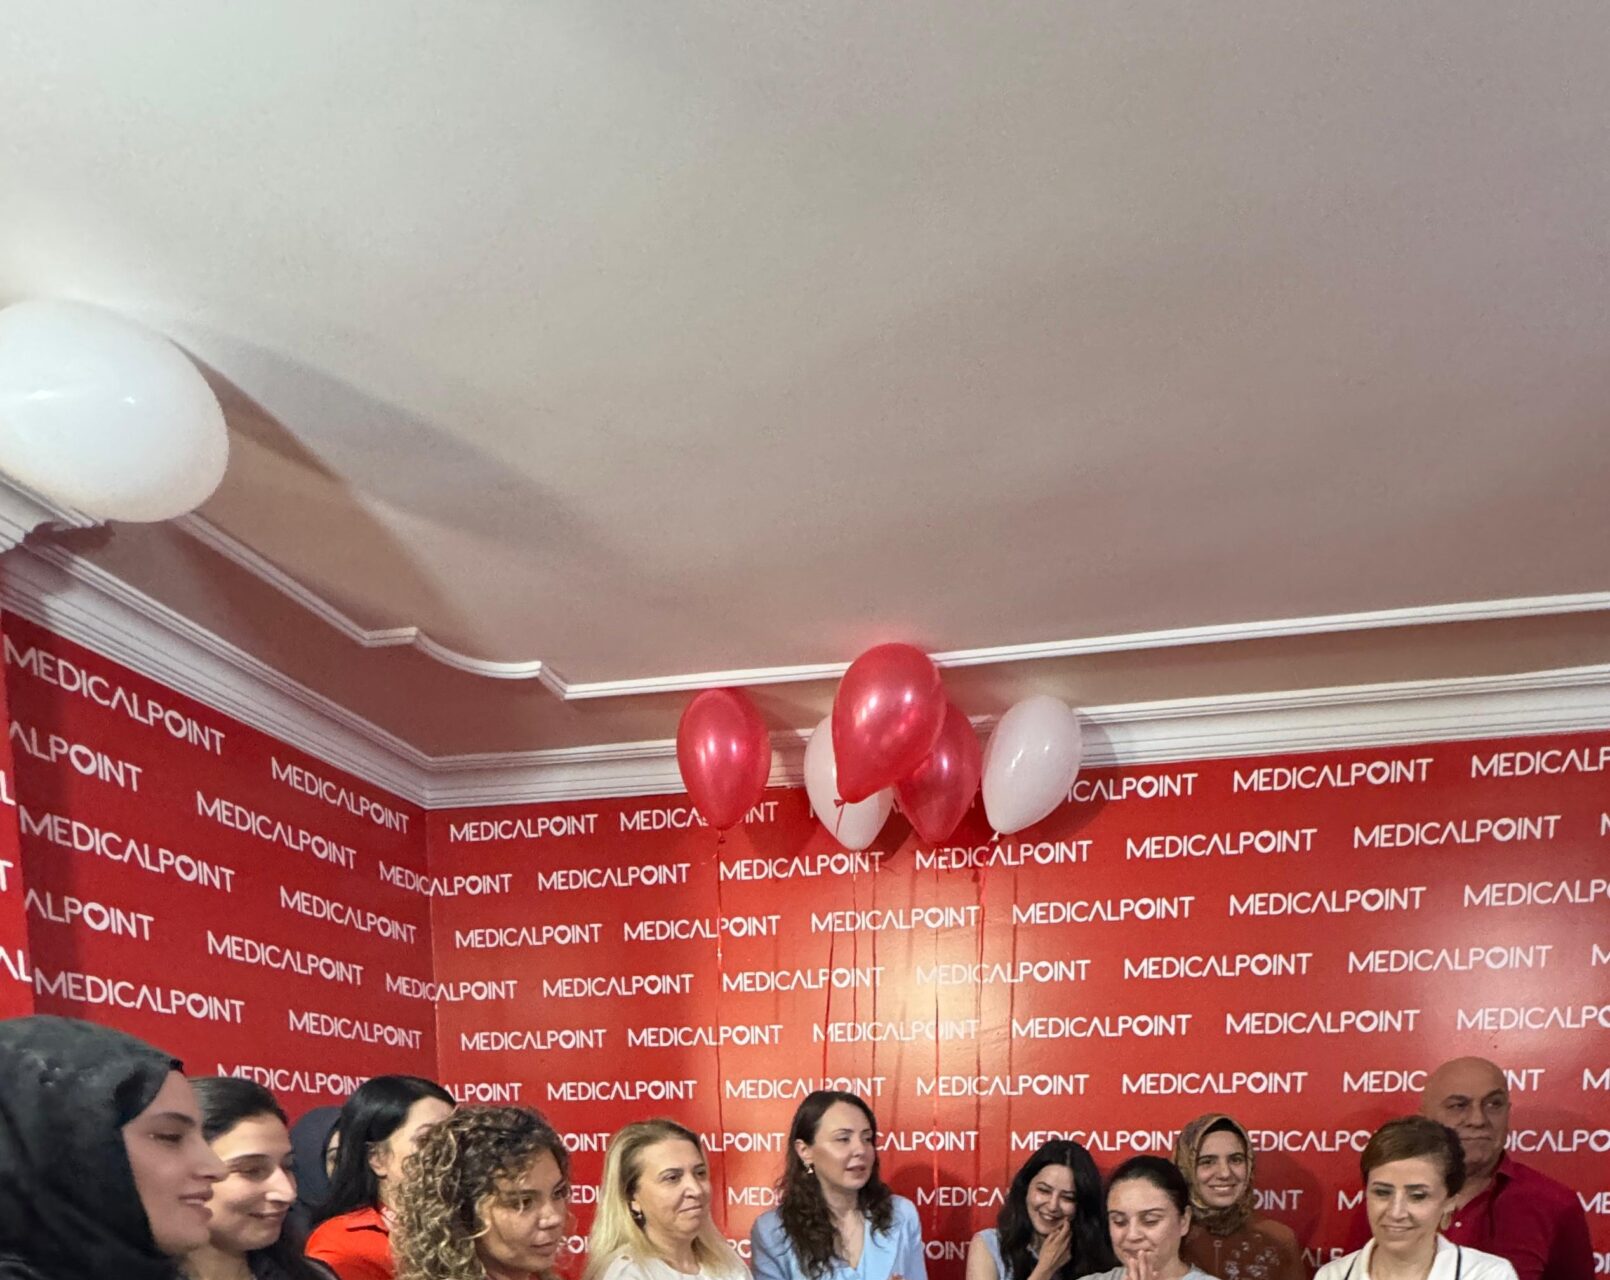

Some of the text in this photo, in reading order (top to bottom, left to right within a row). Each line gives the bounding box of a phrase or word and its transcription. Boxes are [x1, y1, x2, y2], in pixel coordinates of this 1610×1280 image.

[3, 634, 226, 755] MEDICALPOINT
[1233, 758, 1433, 792] MEDICALPOINT
[271, 756, 409, 836] MEDICALPOINT
[196, 791, 357, 869] MEDICALPOINT
[450, 814, 598, 842] MEDICALPOINT
[620, 801, 778, 831] MEDICAINT
[1127, 829, 1317, 859] MEDICALPOINT
[1354, 815, 1561, 848] MEDICALPOINT
[19, 804, 236, 892] MEDICALPOINT
[916, 839, 1093, 869] MEDICALPOINT
[379, 861, 512, 897] MEDICALPOINT
[538, 863, 691, 891] MEDICALPOINT
[720, 852, 884, 881] MEDICALPOINT
[280, 886, 417, 944] MEDICALPOINT
[1013, 896, 1195, 923] MEDICALPOINT
[1230, 887, 1426, 916] MEDICALPOINT
[624, 915, 780, 941] MEDICALPOINT
[811, 906, 980, 933] MEDICALPOINT
[455, 924, 602, 948] MEDICALPOINT
[207, 930, 364, 985] MEDICALPOINT
[1124, 953, 1312, 979] MEDICALPOINT
[1348, 946, 1552, 973] MEDICALPOINT
[543, 974, 694, 997] MEDICALPOINT
[723, 967, 884, 992] MEDICALPOINT
[917, 959, 1092, 985] MEDICALPOINT
[35, 968, 245, 1023] MEDICALPOINT
[386, 973, 517, 1001] MEDICALPOINT
[289, 1009, 422, 1049] MEDICALPOINT
[628, 1025, 783, 1047] MEDICALPOINT
[813, 1019, 980, 1043] MEDICALPOINT
[1012, 1014, 1191, 1038] MEDICALPOINT
[1226, 1010, 1420, 1034] MEDICALPOINT
[461, 1029, 607, 1050] MEDICALPOINT
[547, 1080, 697, 1100] MEDICALPOINT
[917, 1074, 1089, 1096] MEDICALPOINT
[1122, 1072, 1308, 1094] MEDICALPOINT
